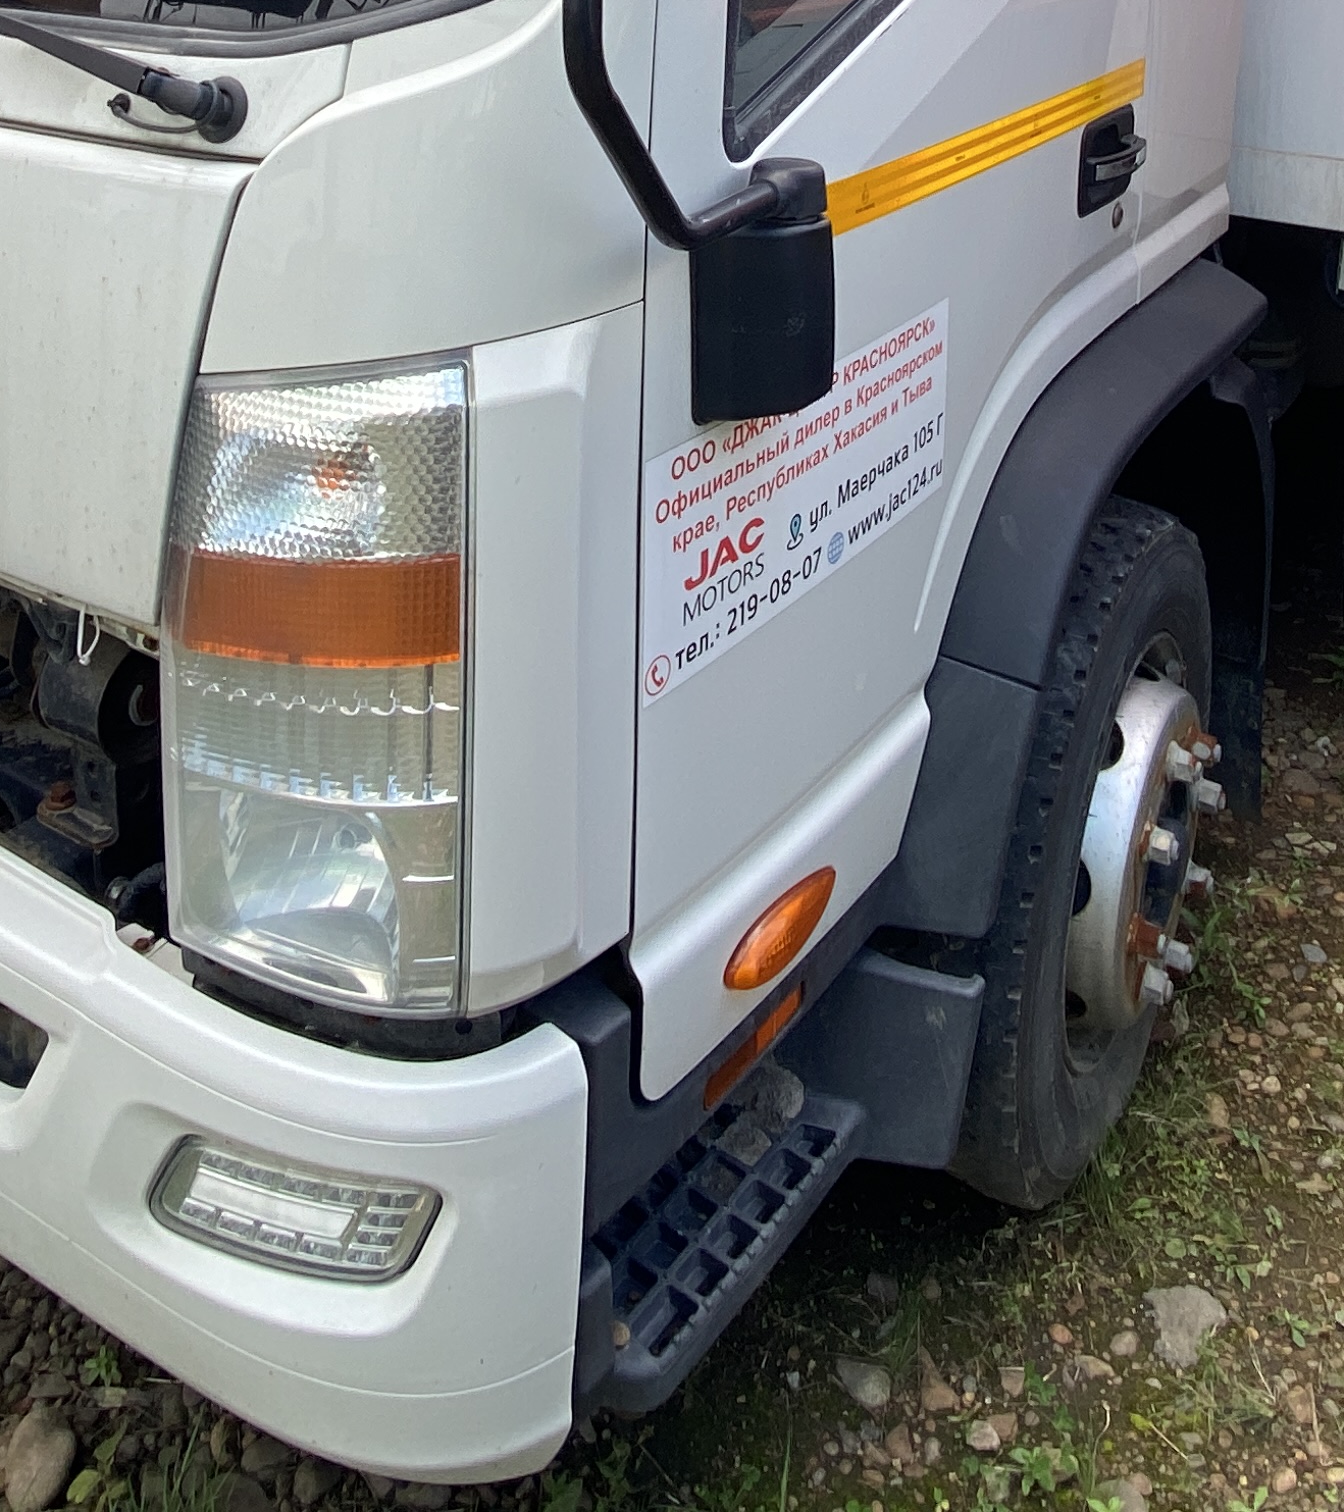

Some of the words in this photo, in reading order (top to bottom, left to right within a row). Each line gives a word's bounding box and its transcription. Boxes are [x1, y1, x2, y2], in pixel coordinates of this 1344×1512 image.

[656, 433, 789, 524] Официальный
[794, 405, 840, 450] дилер
[844, 397, 853, 414] в
[857, 340, 943, 408] Красноярском
[671, 439, 716, 481] ООО
[843, 316, 935, 388] КРАСНОЯРСК»
[673, 513, 720, 554] крае,
[726, 445, 829, 522] Республиках
[833, 405, 888, 453] Хакасия
[890, 398, 899, 414] и
[902, 376, 933, 408] Тыва
[809, 500, 833, 534] ул.
[837, 444, 909, 509] Маерчака
[914, 420, 935, 454] 105
[847, 458, 944, 546] www.jac124.ru
[675, 621, 721, 671] тел.:
[727, 545, 823, 636] 219-08-07
[683, 552, 766, 627] MOTORS
[684, 517, 765, 591] JAC
